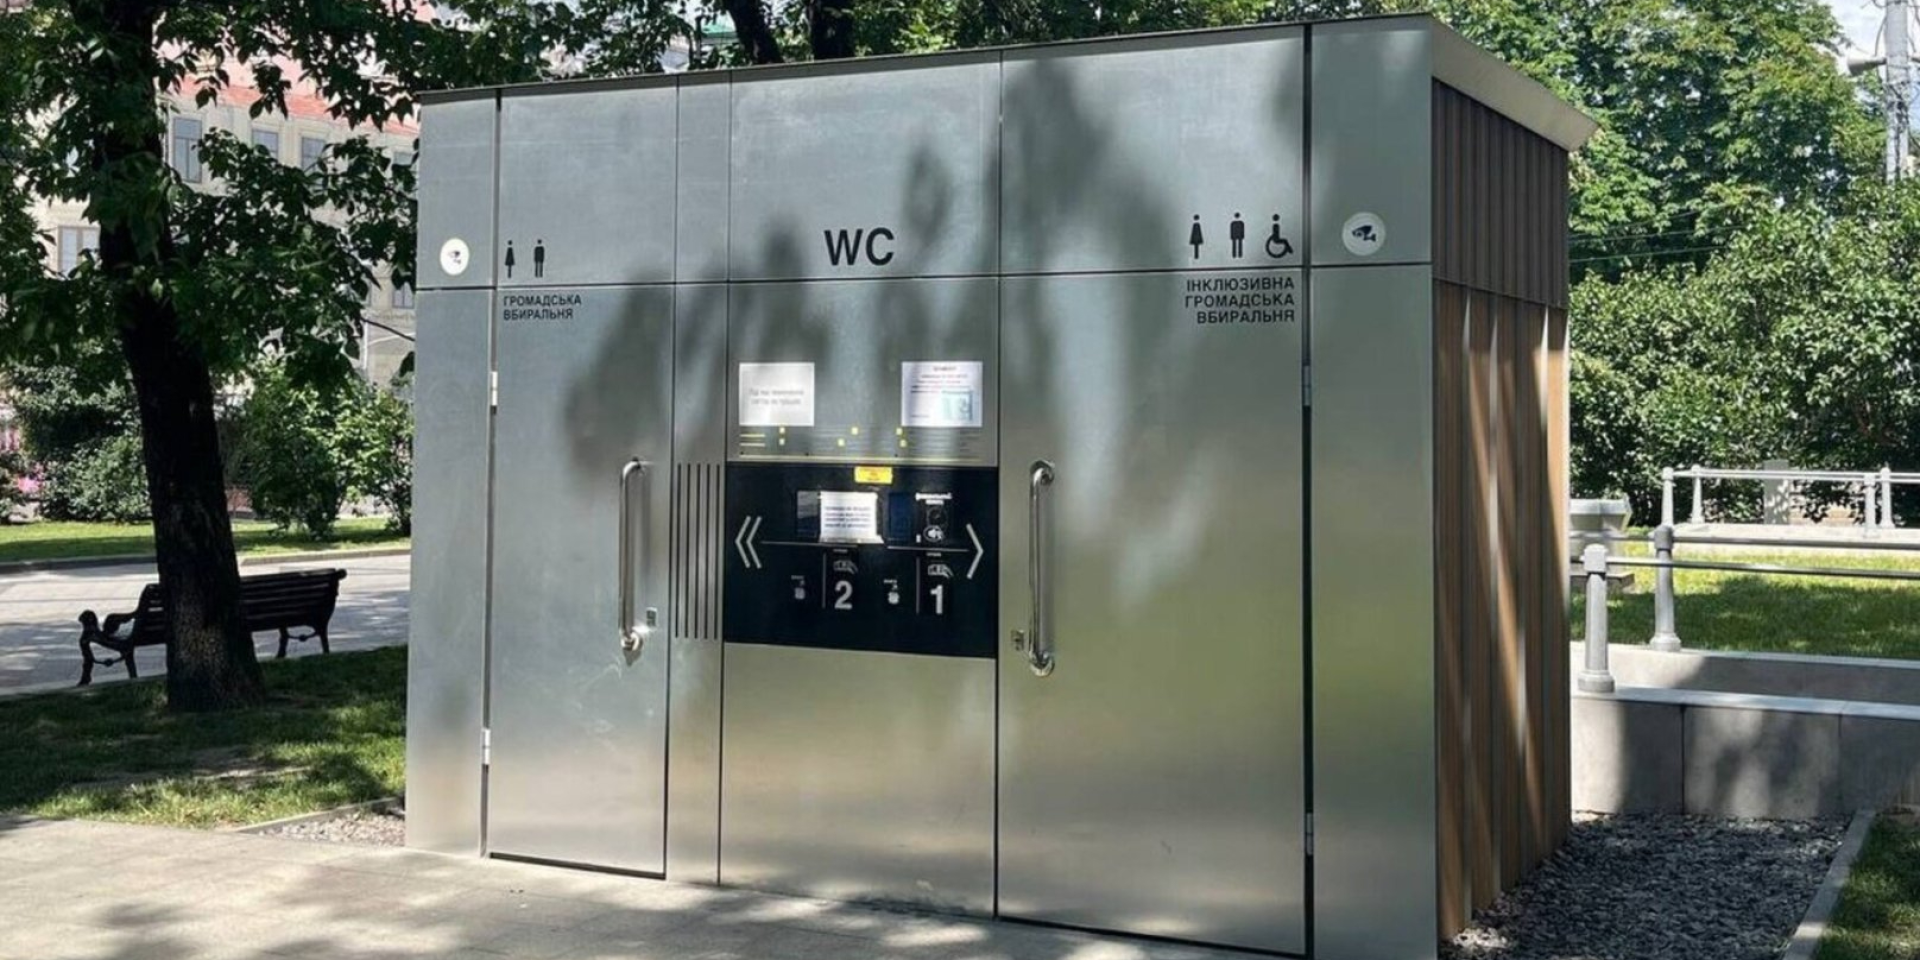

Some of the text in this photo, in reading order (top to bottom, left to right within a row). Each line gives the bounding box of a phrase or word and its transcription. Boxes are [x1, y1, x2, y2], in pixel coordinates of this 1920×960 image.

[824, 226, 895, 266] WC
[1186, 277, 1295, 292] ІНКЛЮЗИВНА
[503, 294, 582, 308] ГРОМАДСЬКА
[1185, 293, 1295, 309] ГРОМАДСЬКА
[503, 308, 574, 321] ВБИРАЛЬНЯ
[1197, 309, 1295, 325] ВБИРАЛЬНЯ
[833, 579, 853, 610] 2
[929, 584, 943, 615] 1
